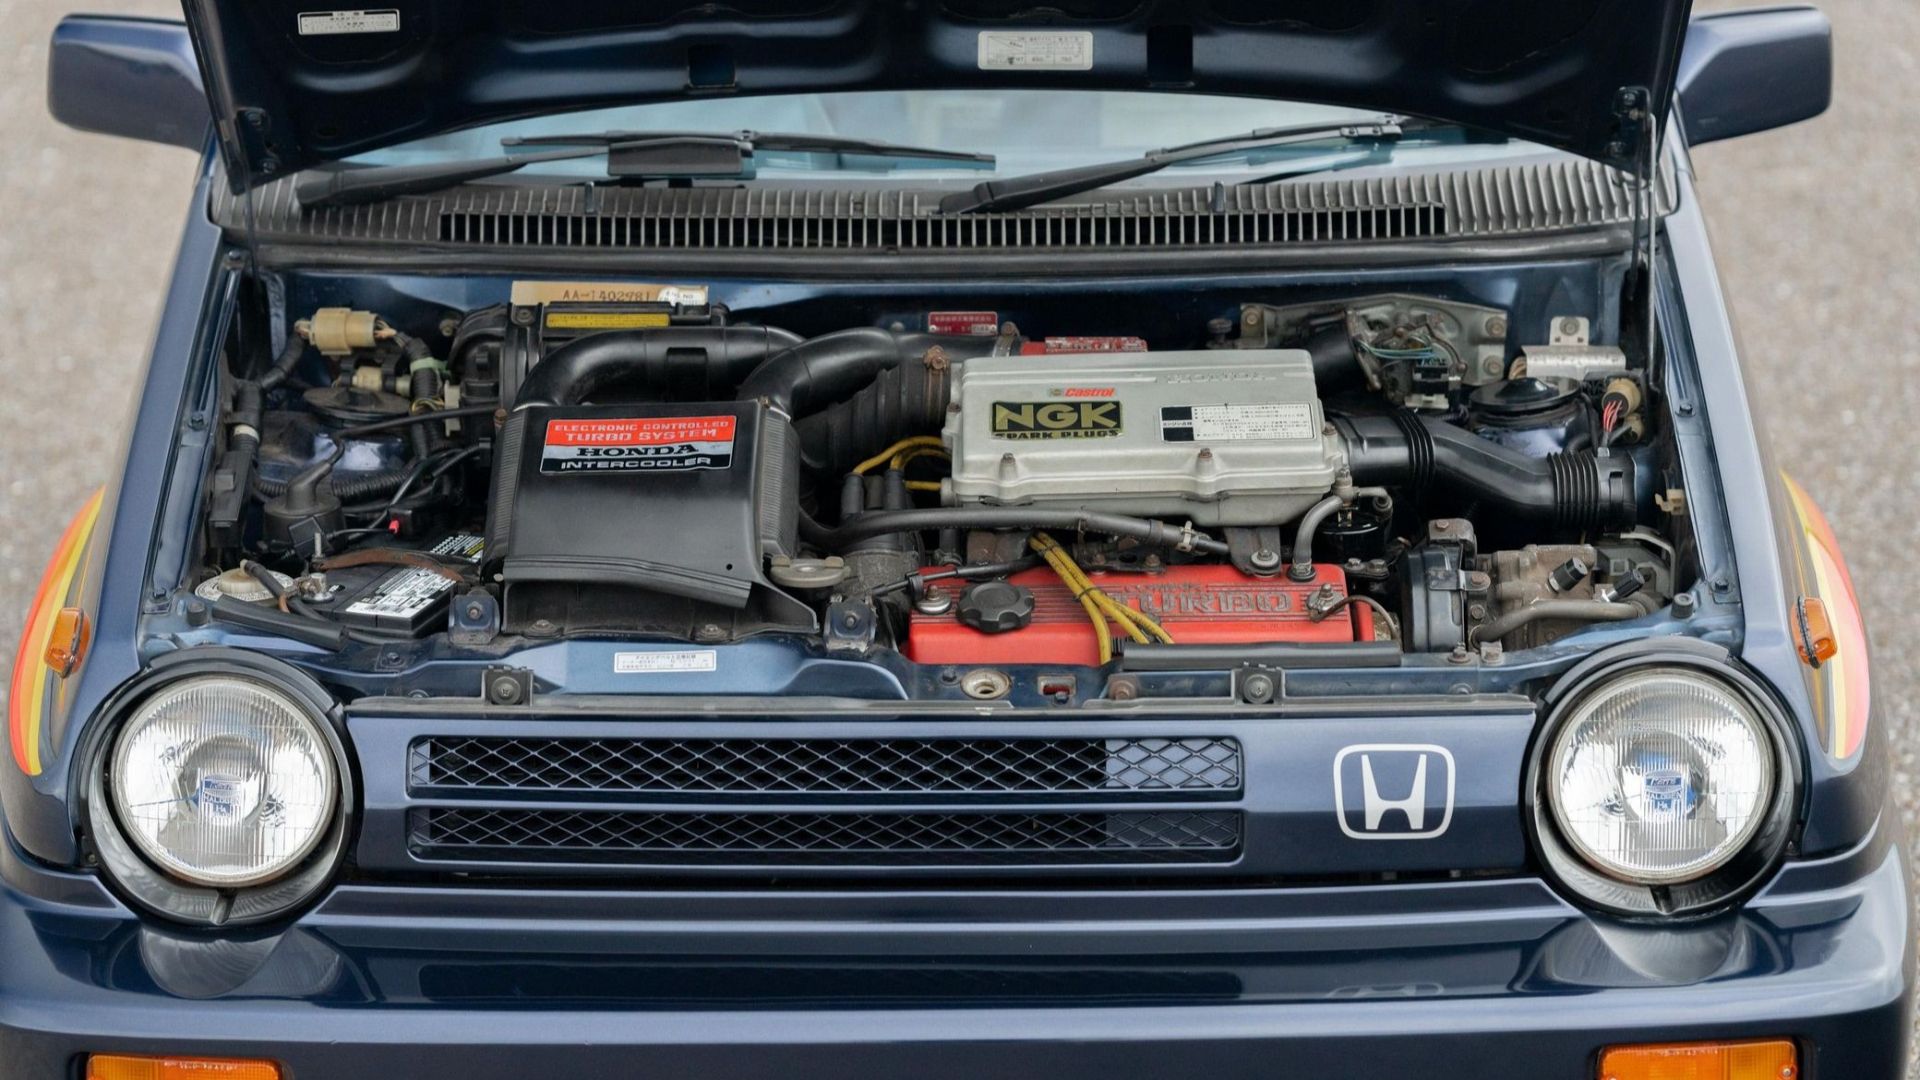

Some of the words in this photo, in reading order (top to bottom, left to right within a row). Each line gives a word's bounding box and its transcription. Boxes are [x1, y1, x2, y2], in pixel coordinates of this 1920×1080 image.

[1064, 388, 1115, 397] Castrol
[995, 402, 1118, 430] NGK
[555, 424, 638, 432] ELECTRONIC
[643, 421, 729, 430] CONTROLLED
[565, 432, 632, 442] TURBO
[638, 429, 717, 441] SYSTEM
[1060, 429, 1119, 439] PLUGS
[577, 444, 700, 457] HONDA
[561, 457, 712, 470] INTERCOOLER
[1105, 591, 1293, 613] TURBO
